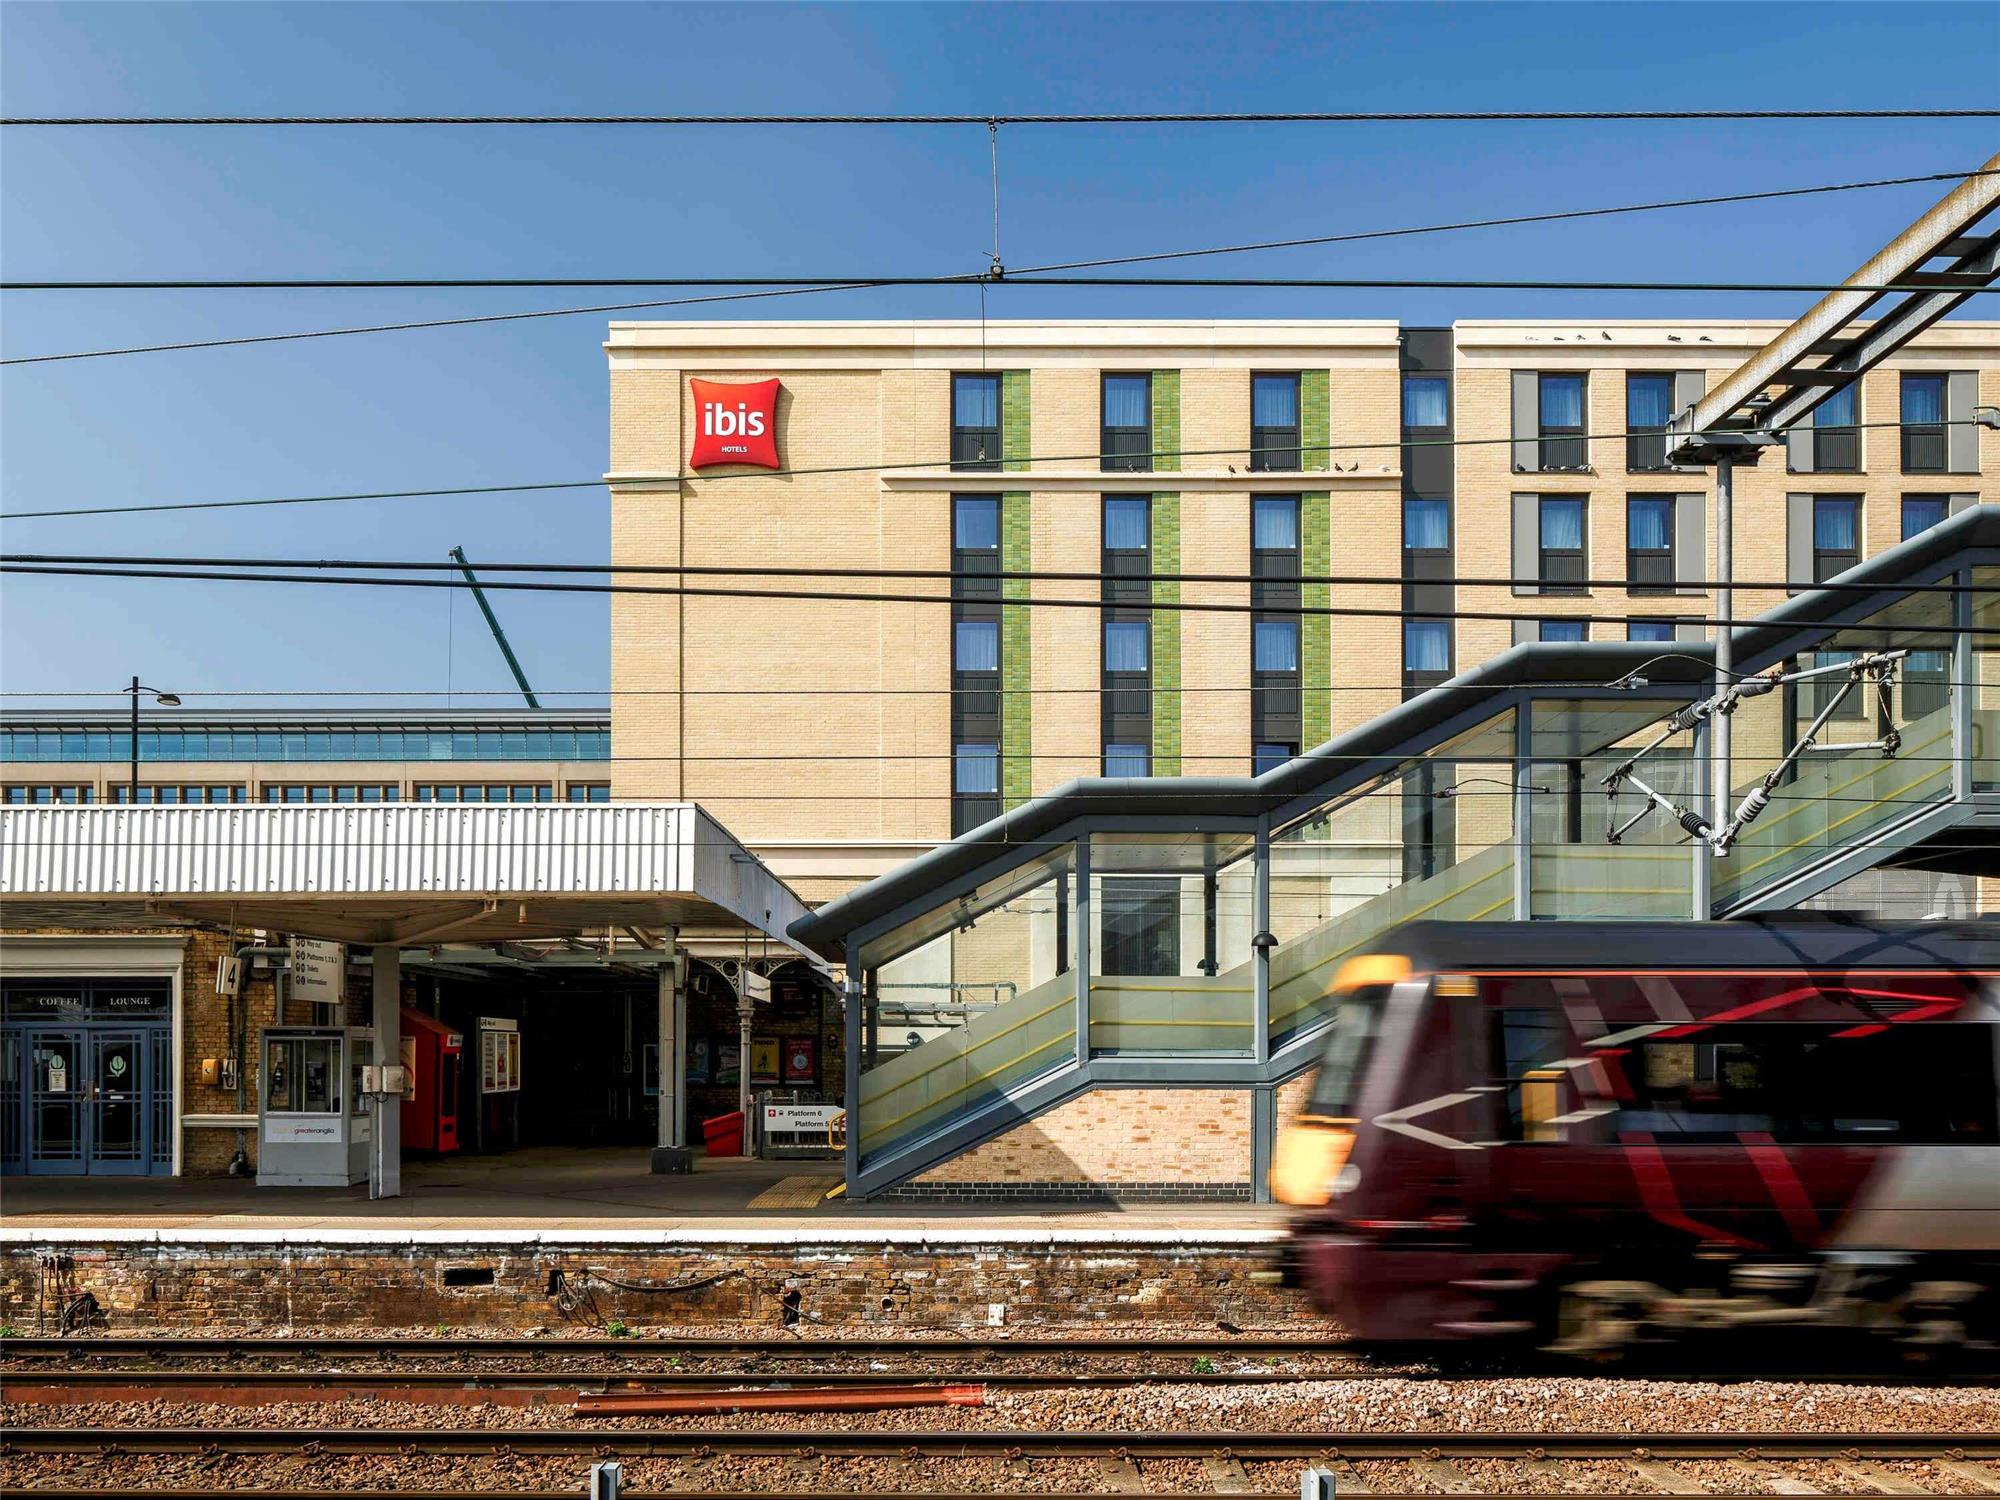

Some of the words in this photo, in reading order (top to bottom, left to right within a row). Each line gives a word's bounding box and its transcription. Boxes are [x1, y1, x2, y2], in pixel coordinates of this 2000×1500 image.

[704, 402, 765, 436] ibis
[228, 963, 236, 989] 4
[39, 997, 80, 1006] COFFEE
[110, 997, 151, 1005] LOUNGE
